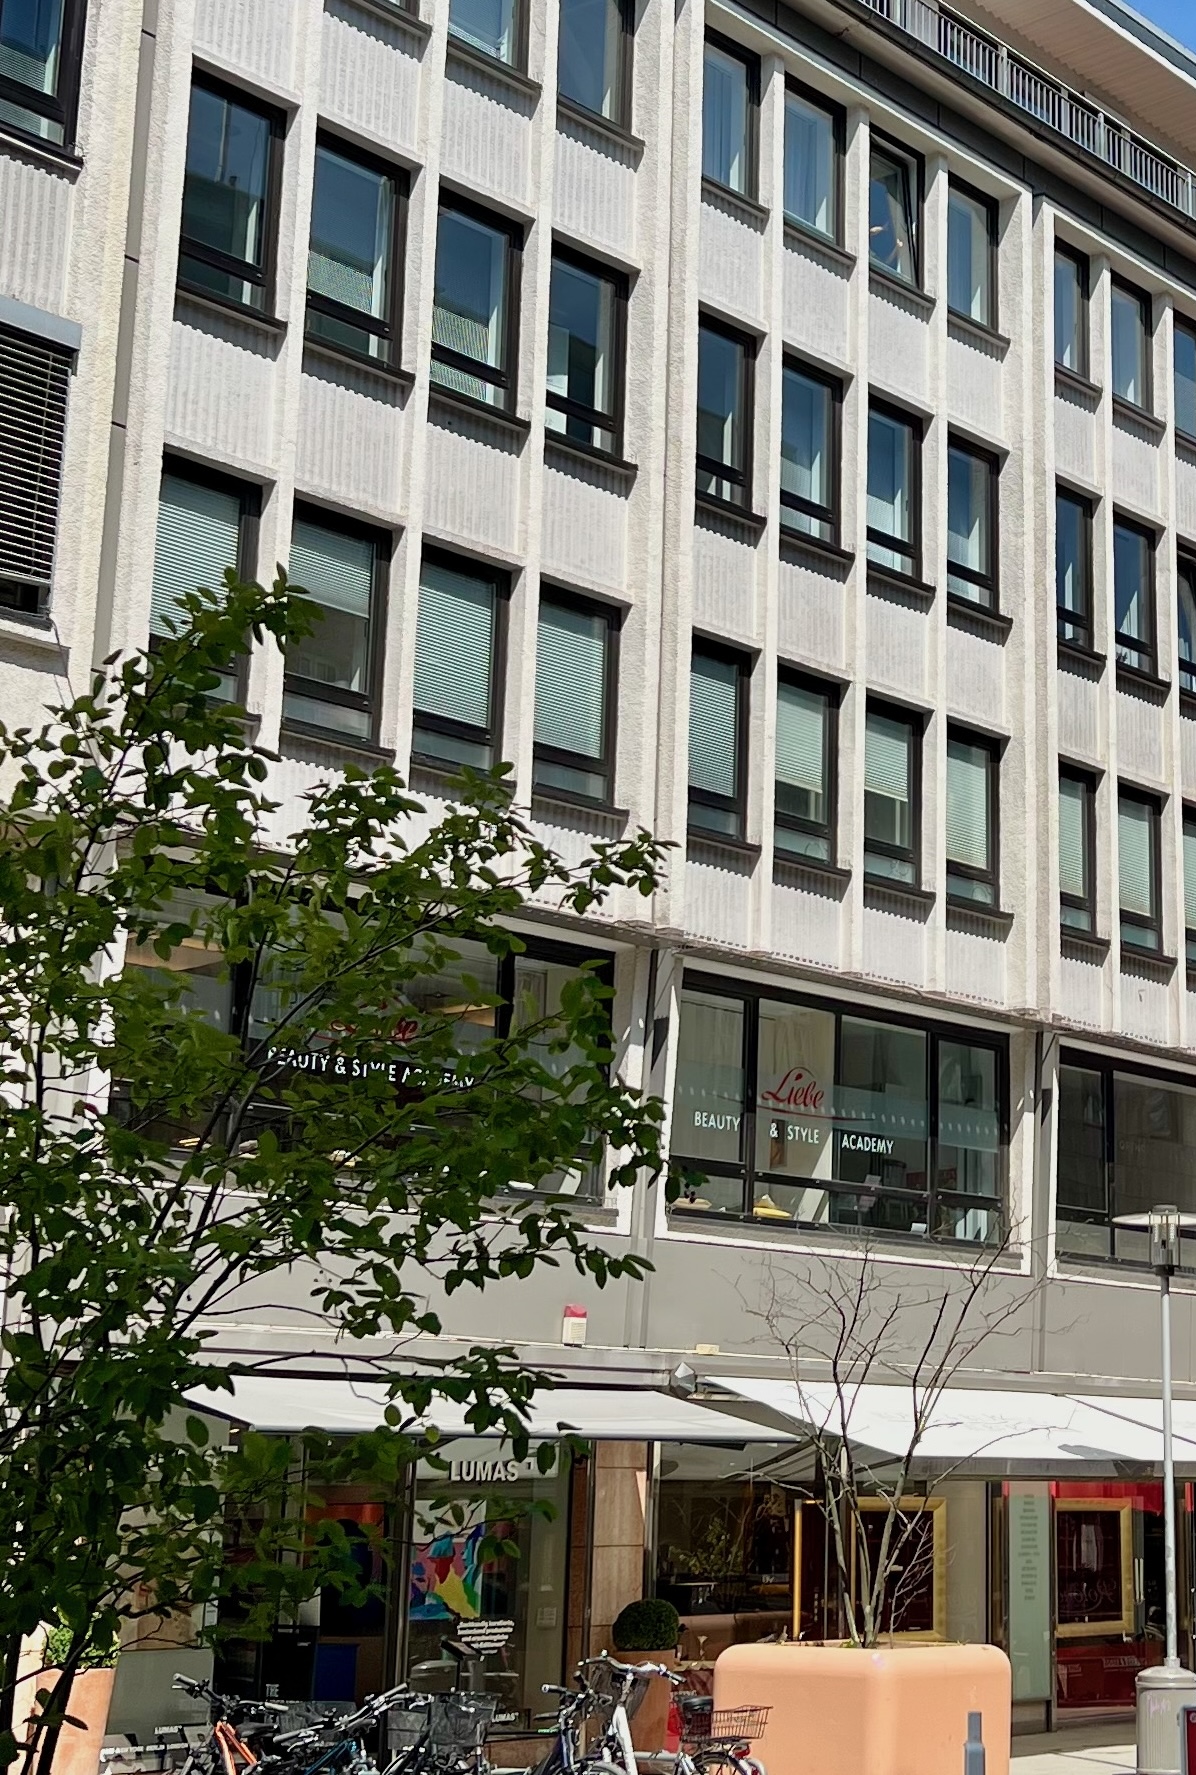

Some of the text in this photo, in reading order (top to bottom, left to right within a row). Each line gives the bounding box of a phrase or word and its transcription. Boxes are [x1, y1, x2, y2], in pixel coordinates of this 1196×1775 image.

[335, 1056, 346, 1074] &
[761, 1066, 825, 1110] Liebe
[694, 1111, 894, 1155] BEAUTY & STYLE ACADEMY
[450, 1460, 519, 1482] LUMAS
